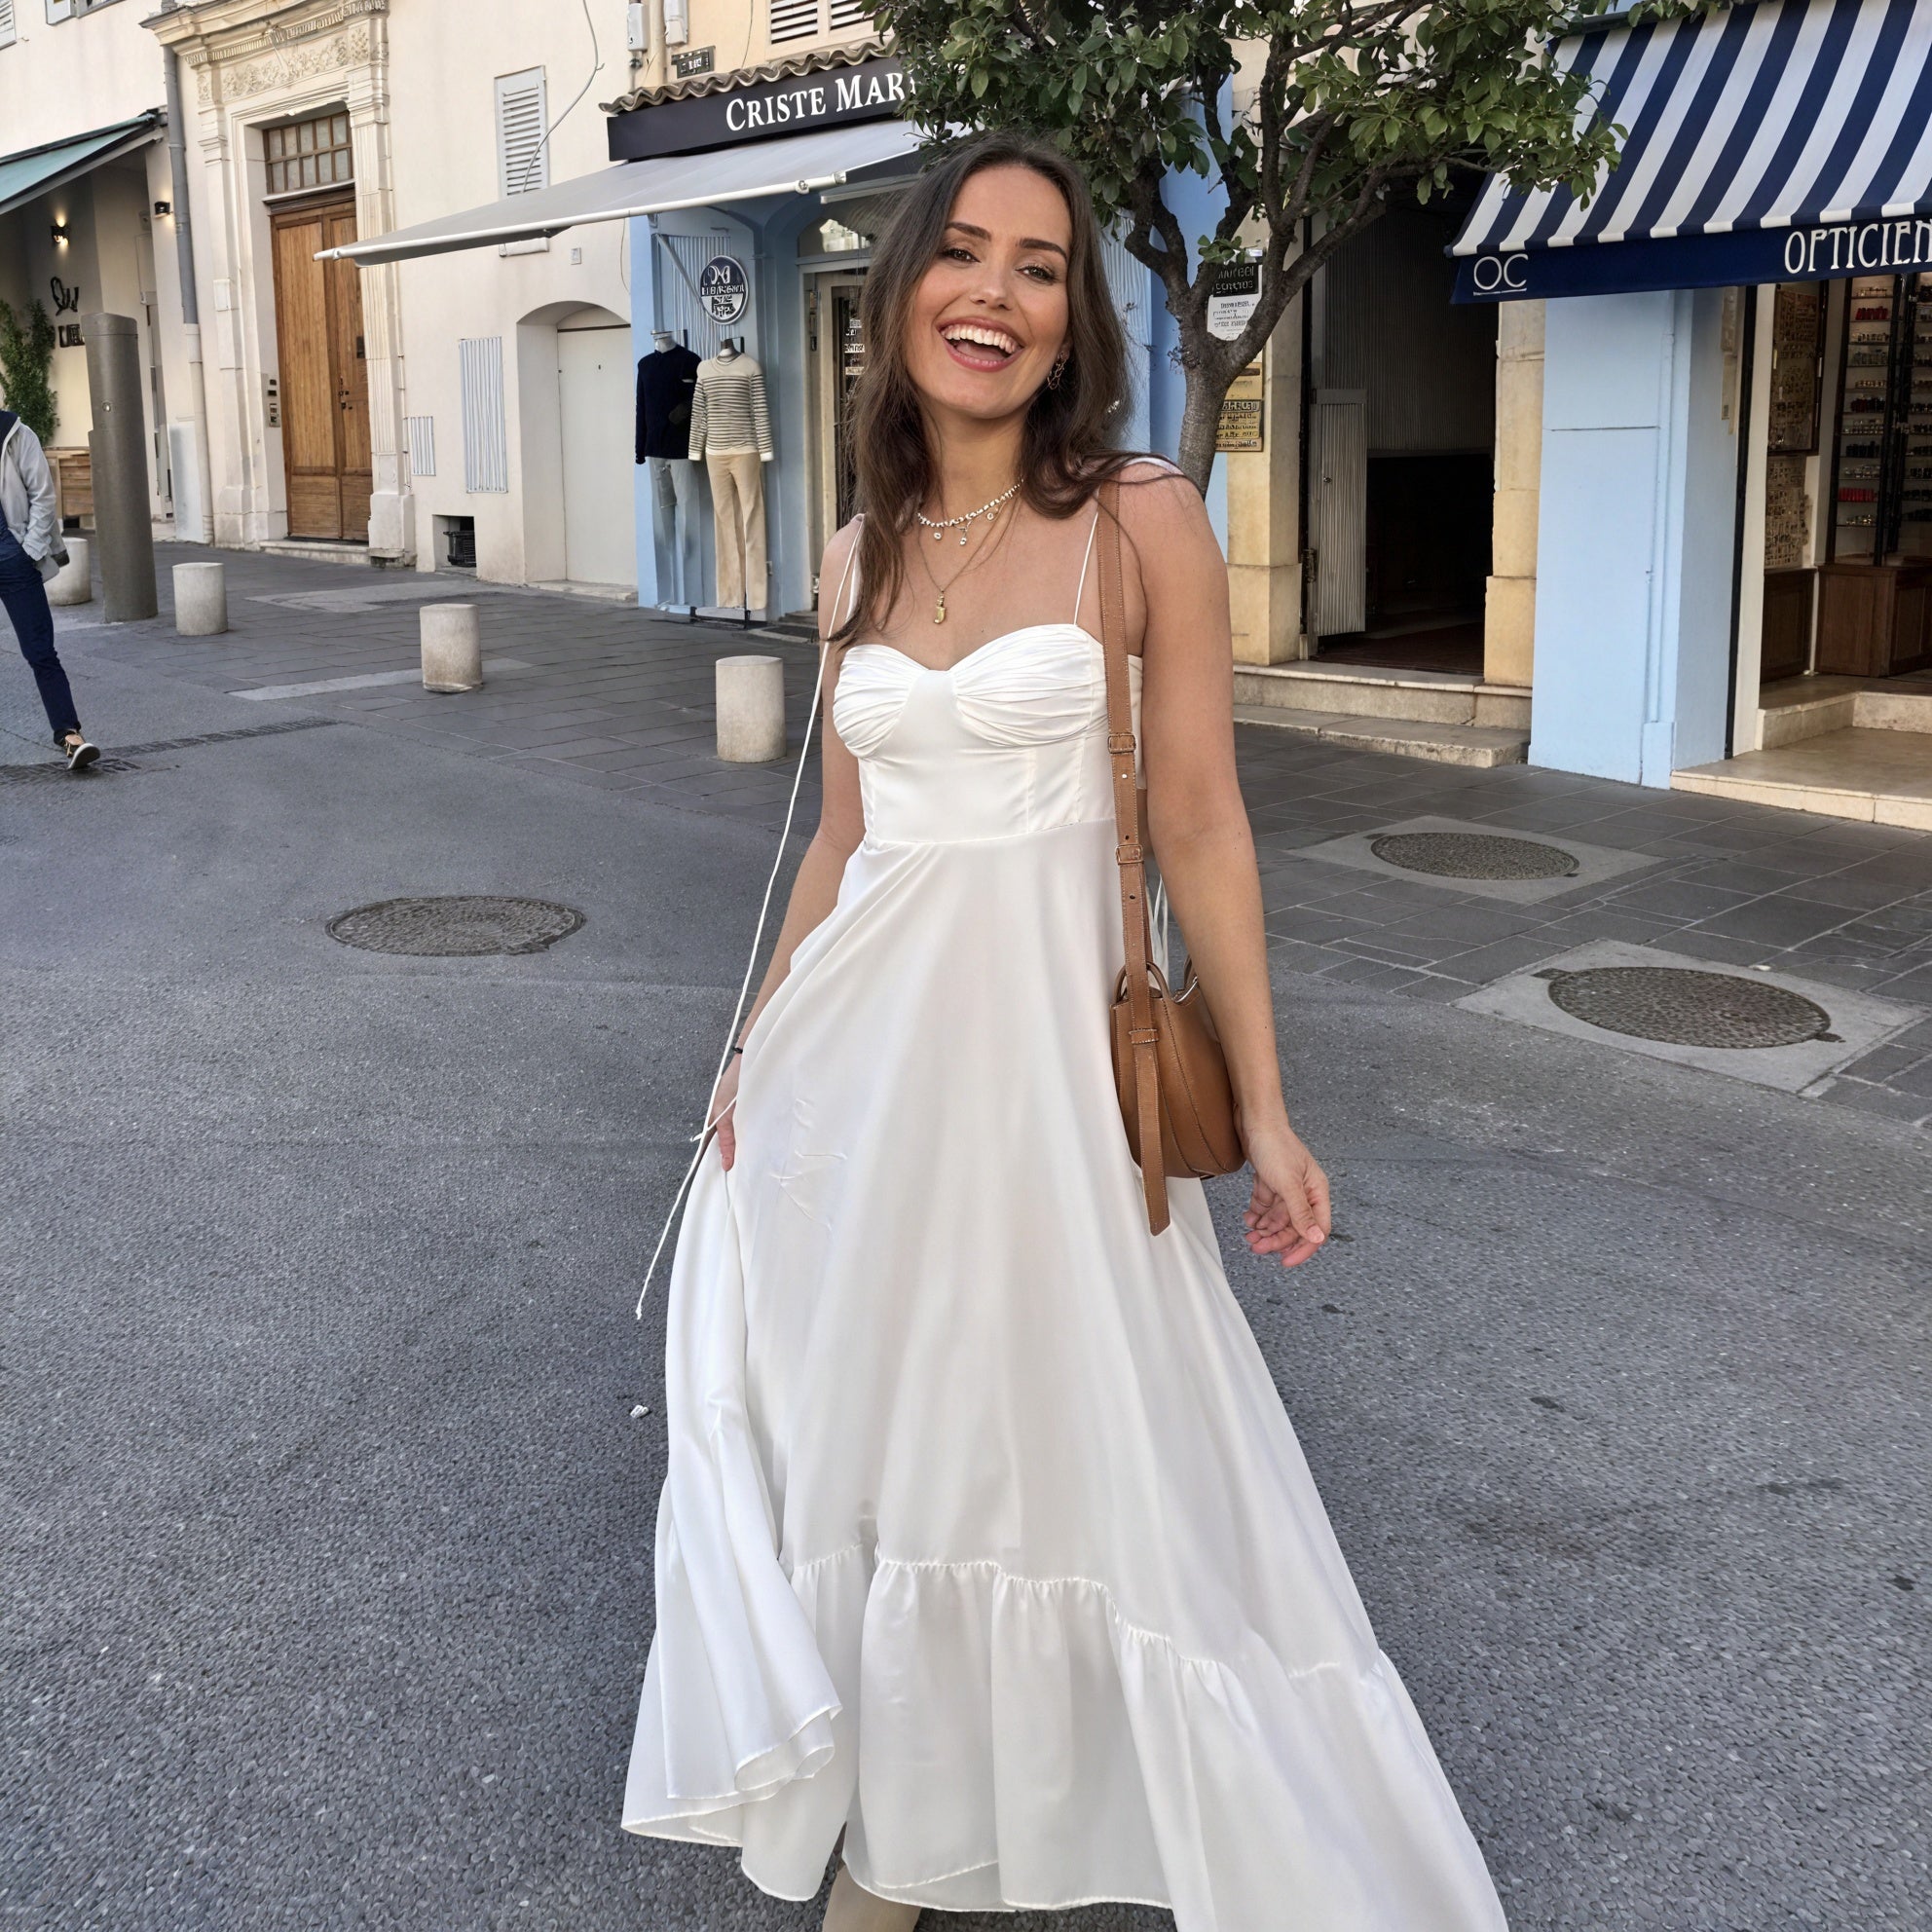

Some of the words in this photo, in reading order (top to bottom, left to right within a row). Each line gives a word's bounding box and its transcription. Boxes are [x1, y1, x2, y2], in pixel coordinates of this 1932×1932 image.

[725, 87, 827, 131] CRISTE
[1784, 218, 1932, 274] OPTICIEN
[1473, 253, 1529, 290] OC
